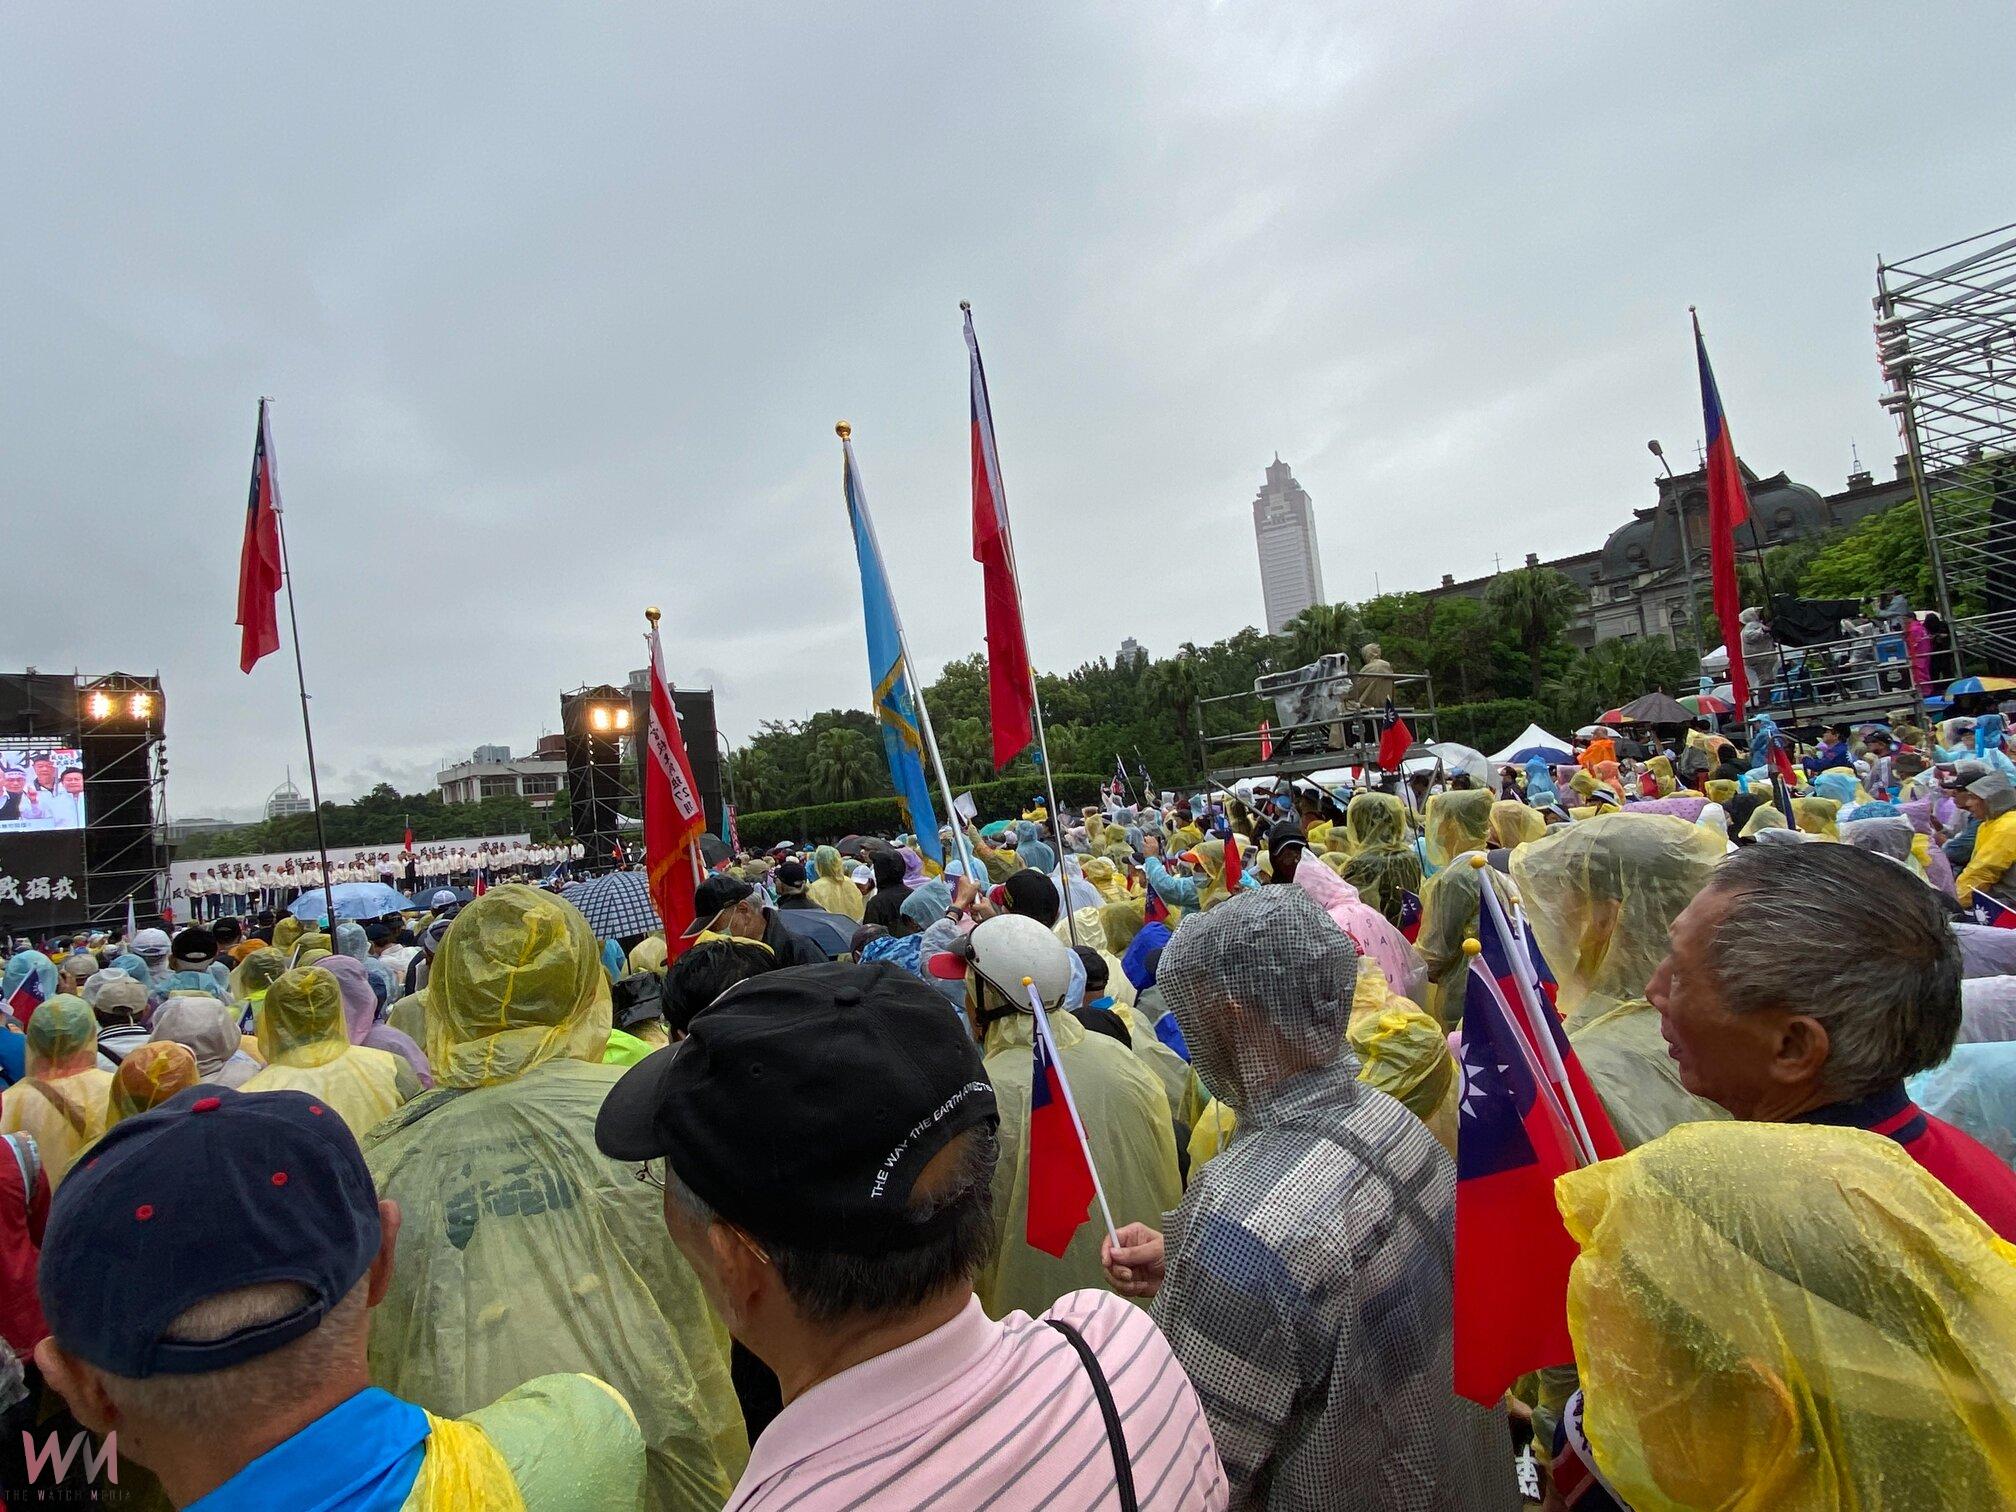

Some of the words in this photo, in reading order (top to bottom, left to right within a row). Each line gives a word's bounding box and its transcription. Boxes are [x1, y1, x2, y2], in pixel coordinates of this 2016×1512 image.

[871, 1169, 889, 1198] THE
[884, 1139, 908, 1168] WAY
[909, 1117, 932, 1139] THE
[933, 1090, 963, 1121] EARTH
